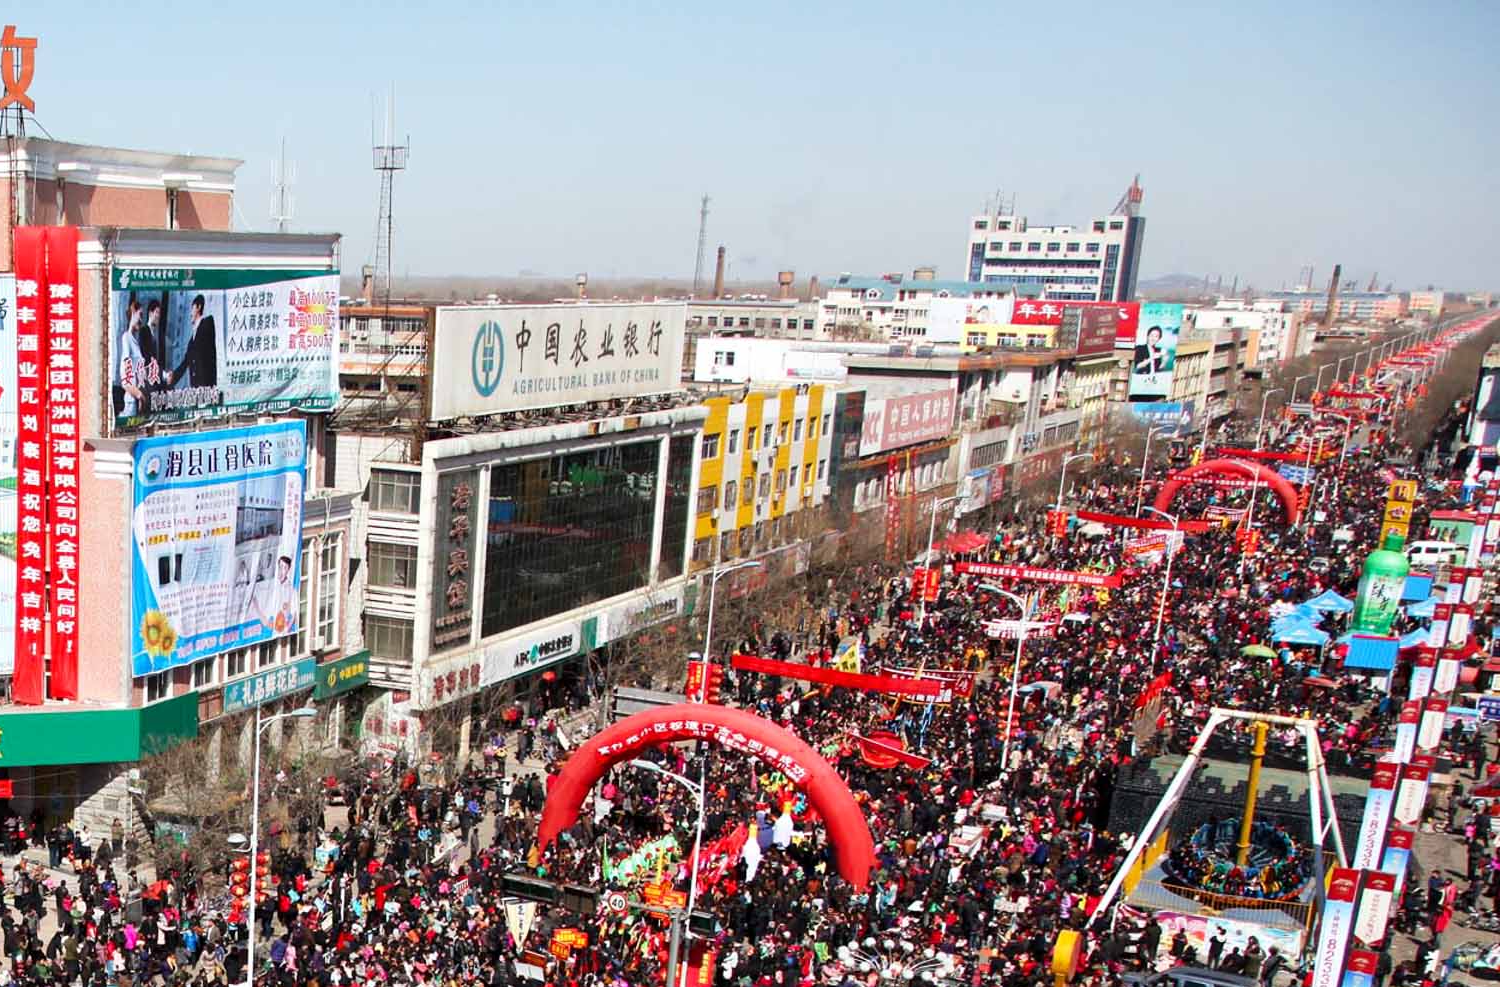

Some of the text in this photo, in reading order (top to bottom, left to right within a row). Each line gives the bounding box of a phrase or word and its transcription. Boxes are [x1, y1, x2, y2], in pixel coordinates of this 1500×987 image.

[515, 319, 664, 373] 中国农业银行
[512, 367, 660, 395] AGRICULTURAL BANK OF CHINA
[165, 440, 273, 478] 滑县正骨医院
[611, 897, 624, 908] 40
